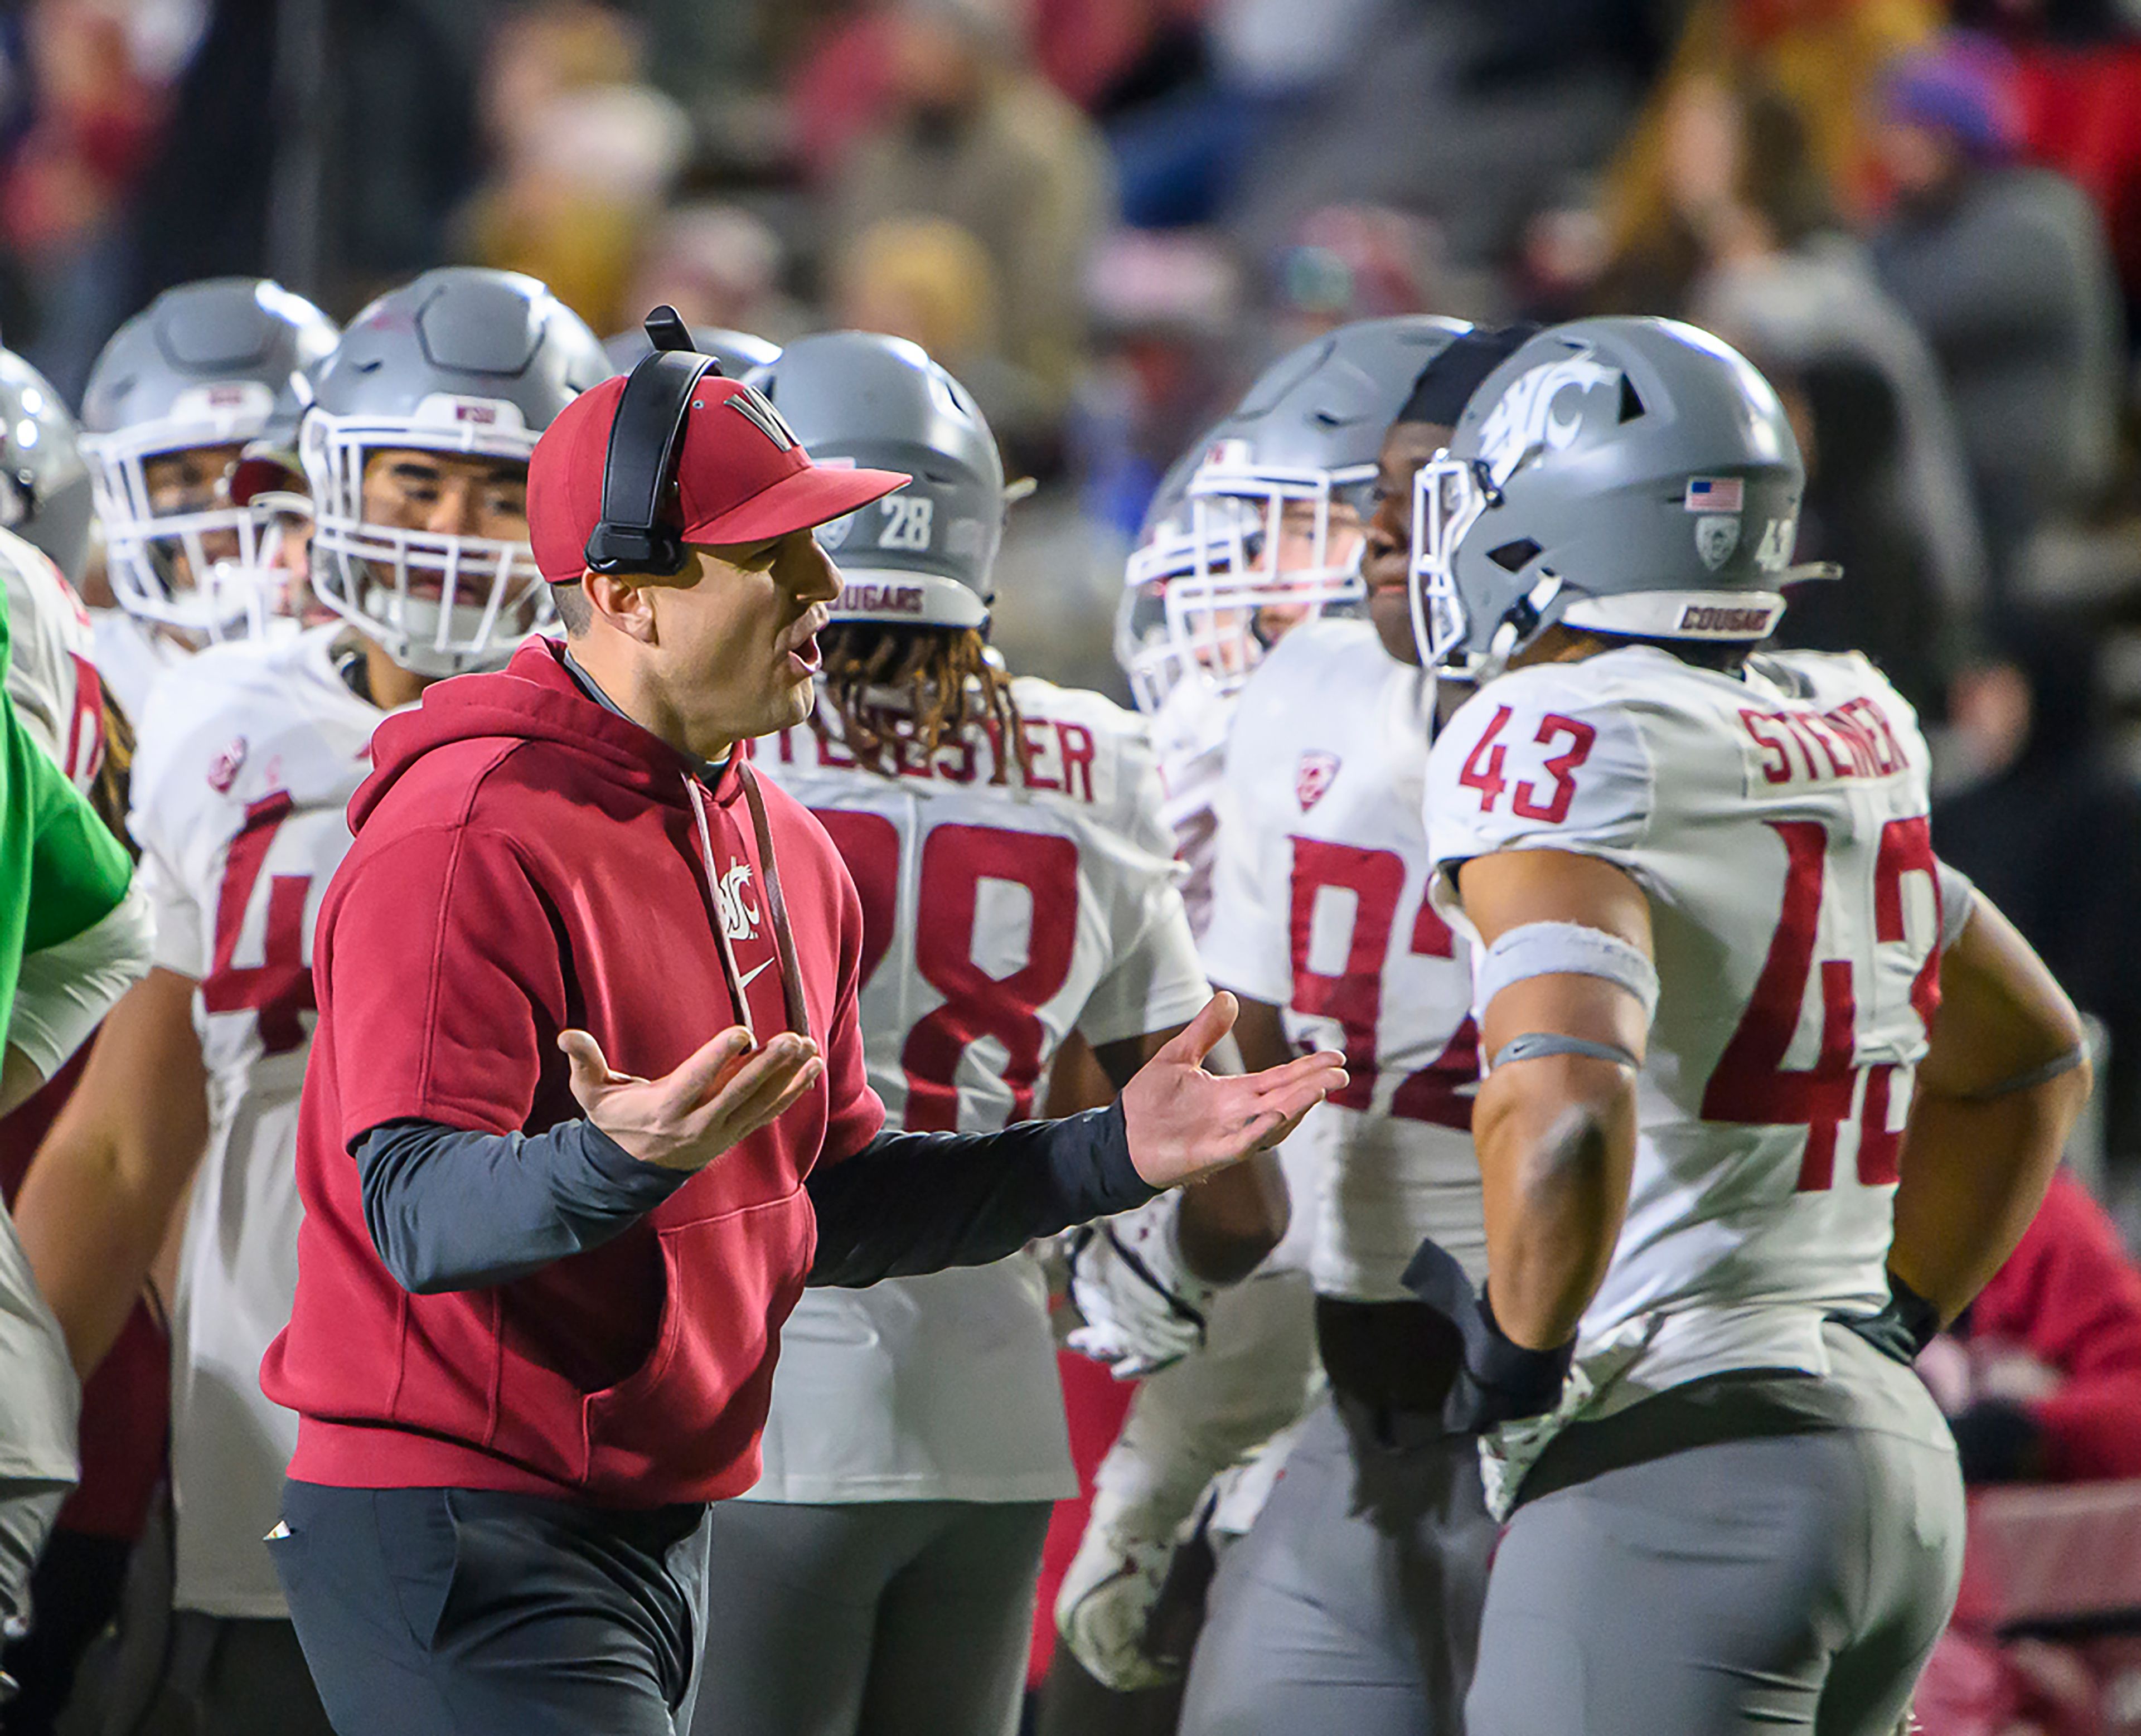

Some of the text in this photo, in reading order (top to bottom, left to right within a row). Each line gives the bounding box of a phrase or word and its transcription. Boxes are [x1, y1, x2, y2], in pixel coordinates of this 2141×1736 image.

[878, 495, 933, 552] 28
[1459, 705, 1596, 824] 43
[1699, 816, 1943, 1192] 43
